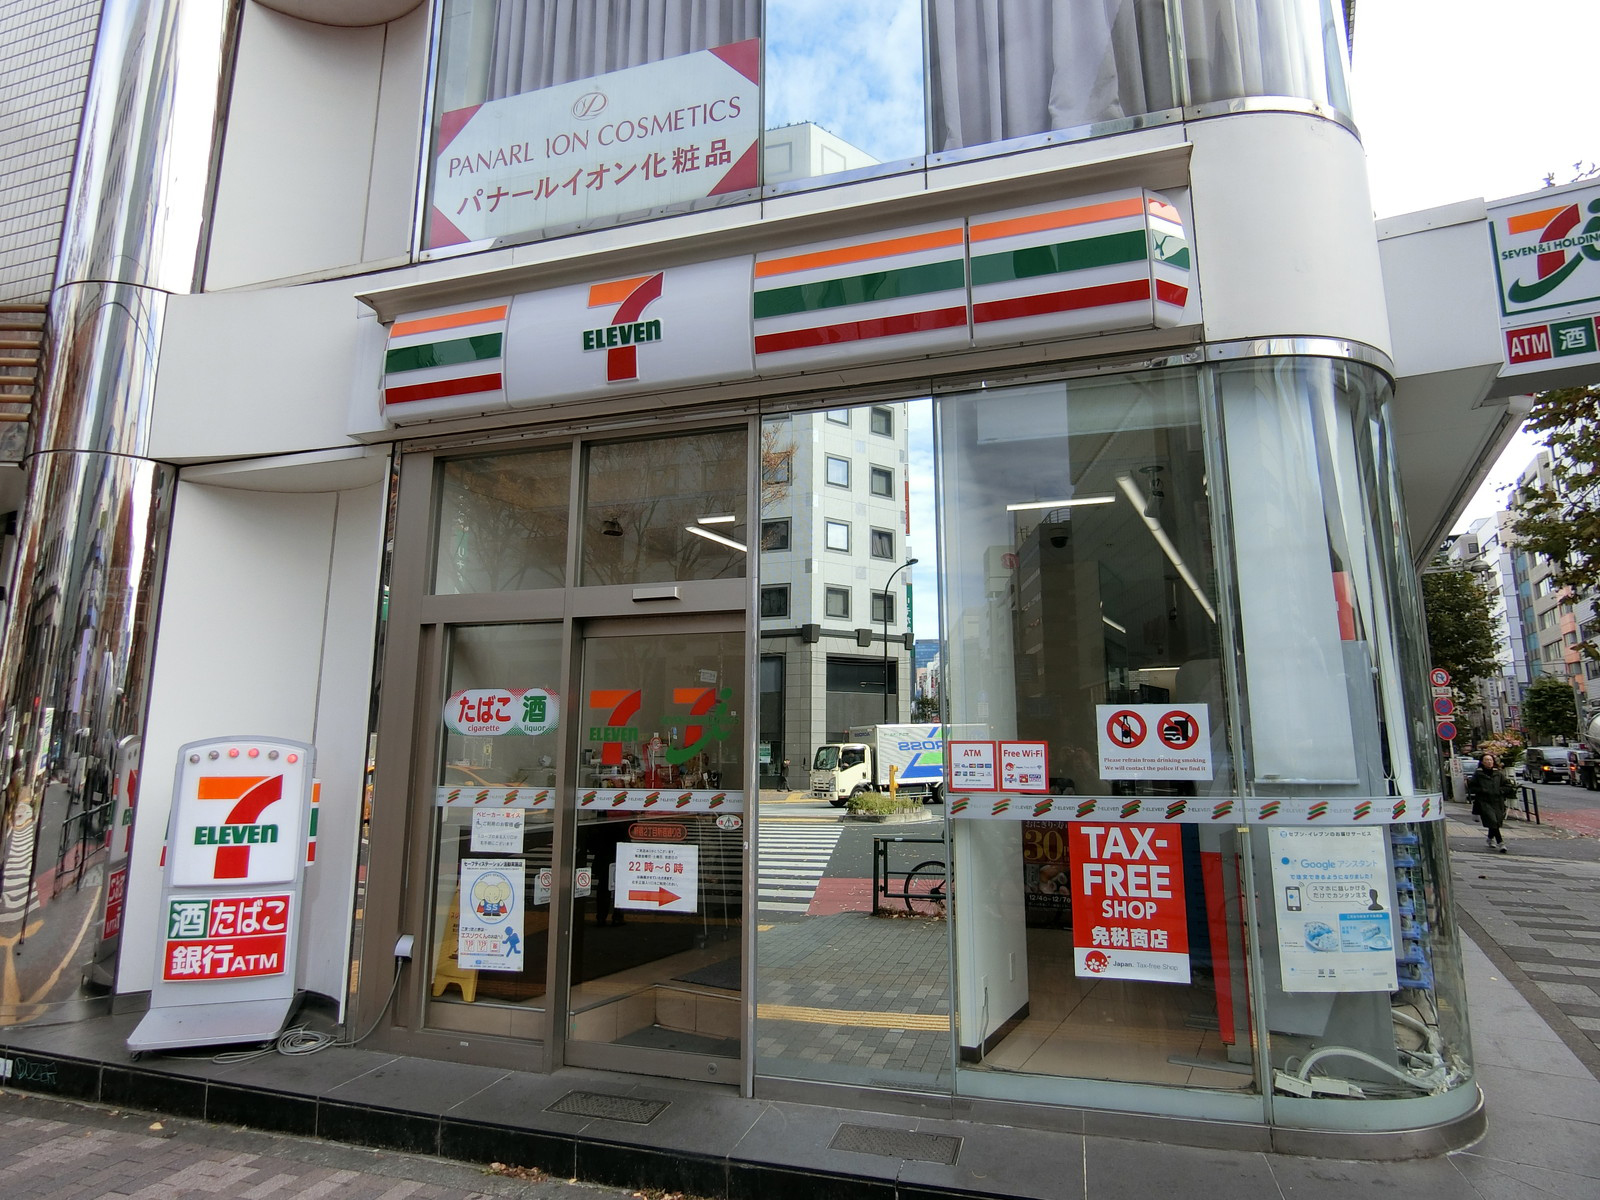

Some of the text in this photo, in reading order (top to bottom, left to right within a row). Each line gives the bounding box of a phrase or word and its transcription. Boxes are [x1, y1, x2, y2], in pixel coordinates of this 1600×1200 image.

[448, 96, 742, 178] PANARL ION COSMETICS
[456, 138, 732, 215] パナールイオン化粧品
[1511, 332, 1549, 358] ATM
[1559, 326, 1588, 350] 酒
[458, 695, 547, 723] たばこ 酒
[467, 724, 547, 734] cigarette liquor
[963, 749, 982, 757] ATM
[1003, 750, 1020, 758] Free
[1080, 826, 1168, 861] TAX-
[1301, 859, 1378, 870] Google アシスタント
[1082, 863, 1172, 899] FREE
[170, 899, 286, 938] 酒 たばこ
[485, 903, 499, 911] SS
[1102, 899, 1157, 920] SHOP
[1091, 926, 1168, 949] 免税商店
[171, 944, 278, 976] 銀行 ATM
[1113, 961, 1178, 971] Japan. Tax-free Shop
